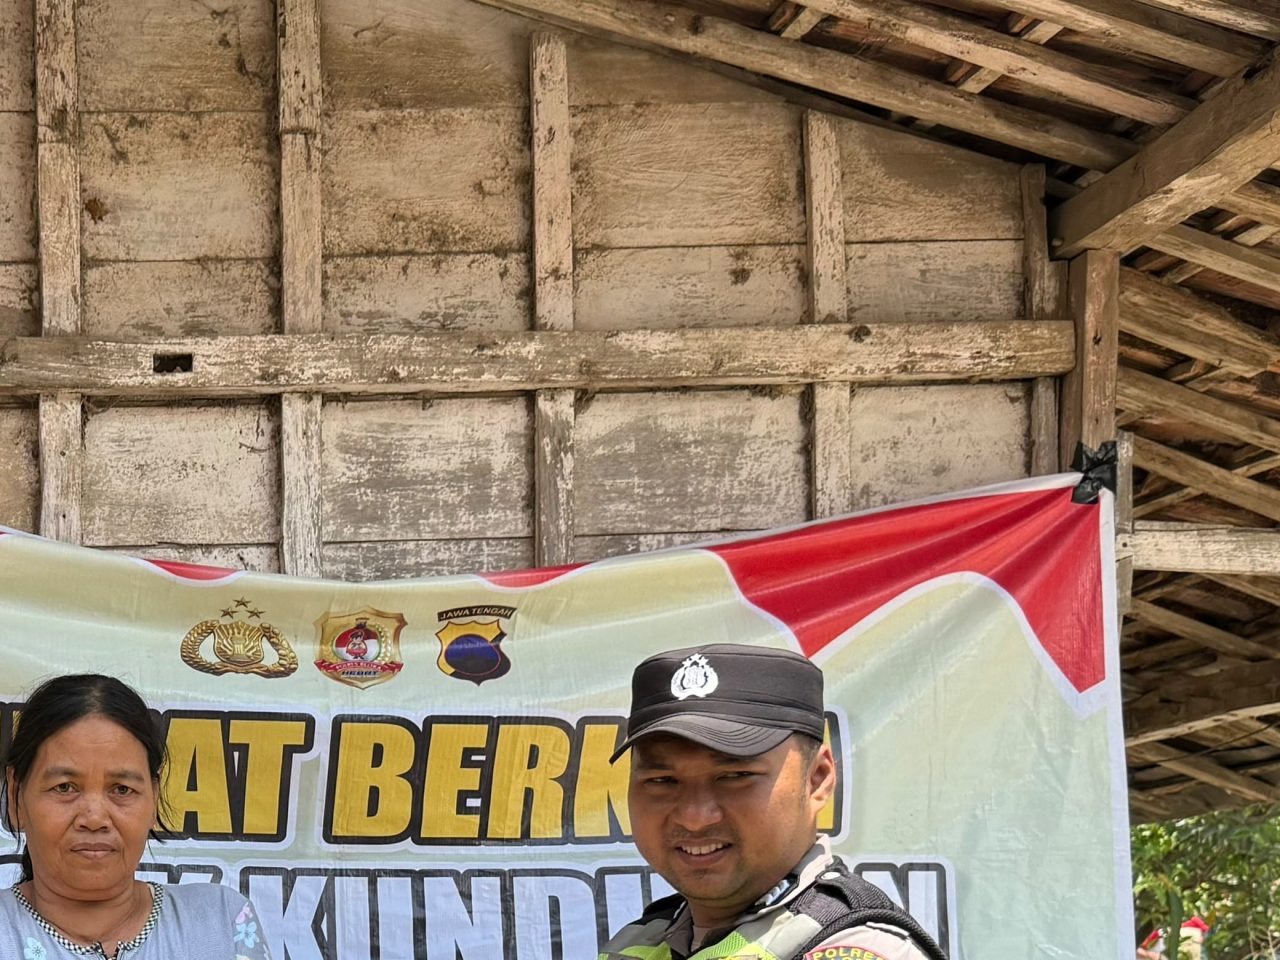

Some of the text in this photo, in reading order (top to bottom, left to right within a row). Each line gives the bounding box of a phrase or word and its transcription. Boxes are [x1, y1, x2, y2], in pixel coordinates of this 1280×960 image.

[440, 607, 513, 620] JAWA TENGAH
[322, 712, 842, 847] BERK
